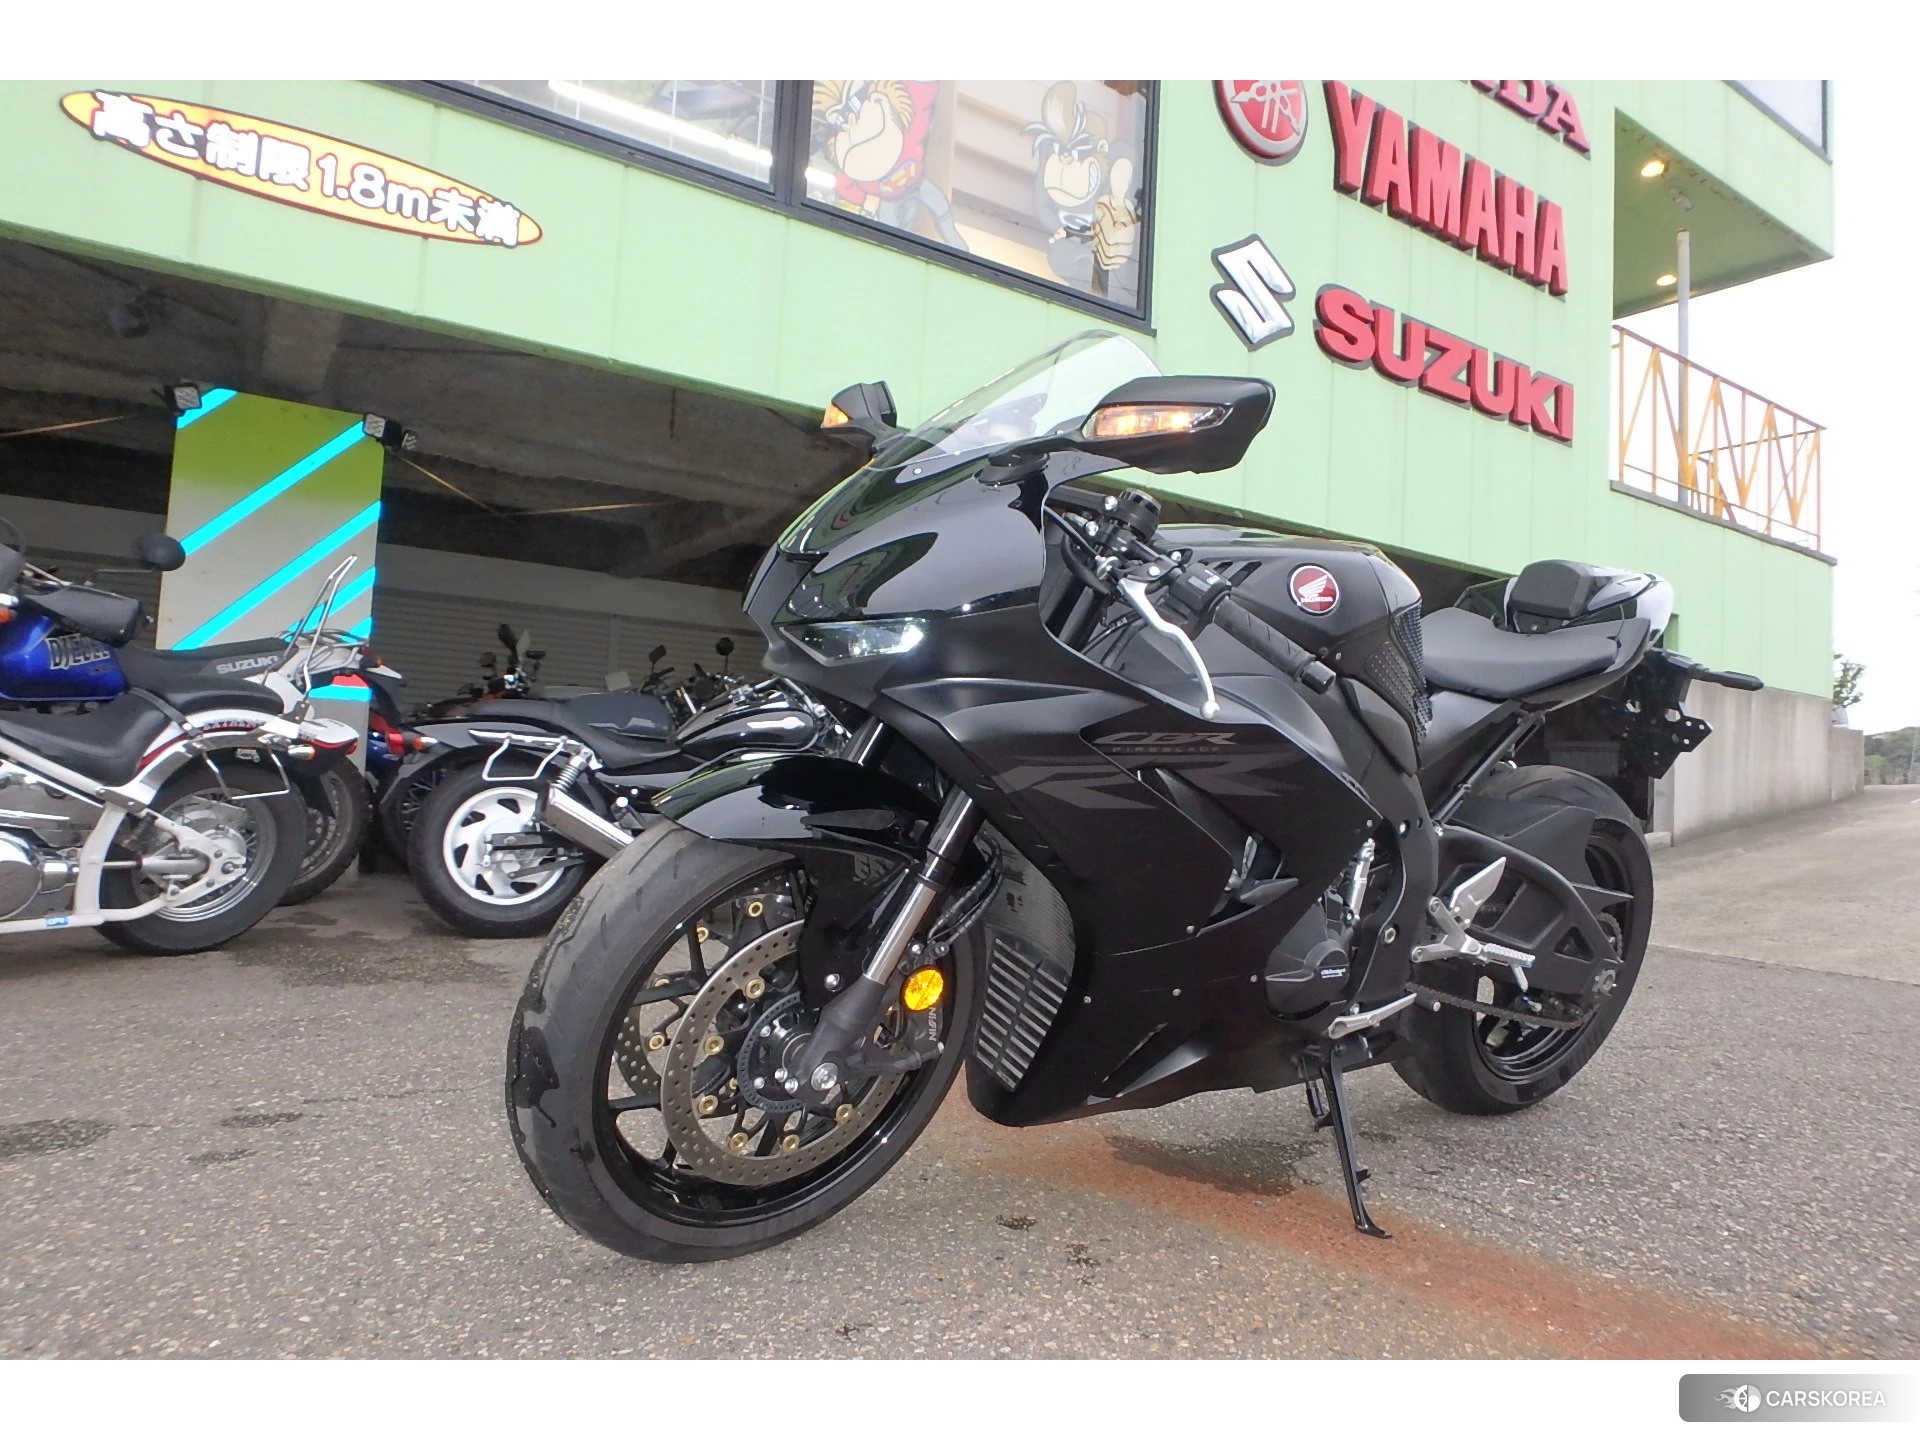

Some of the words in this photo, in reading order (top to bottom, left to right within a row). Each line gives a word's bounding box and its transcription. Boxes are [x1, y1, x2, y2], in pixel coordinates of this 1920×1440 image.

[92, 90, 521, 247] 高さ制限1.8m未満
[1324, 81, 1569, 296] YAMAHA
[1315, 289, 1575, 444] SUZUKI
[216, 656, 279, 674] SUZUKI
[1093, 732, 1237, 745] CBR
